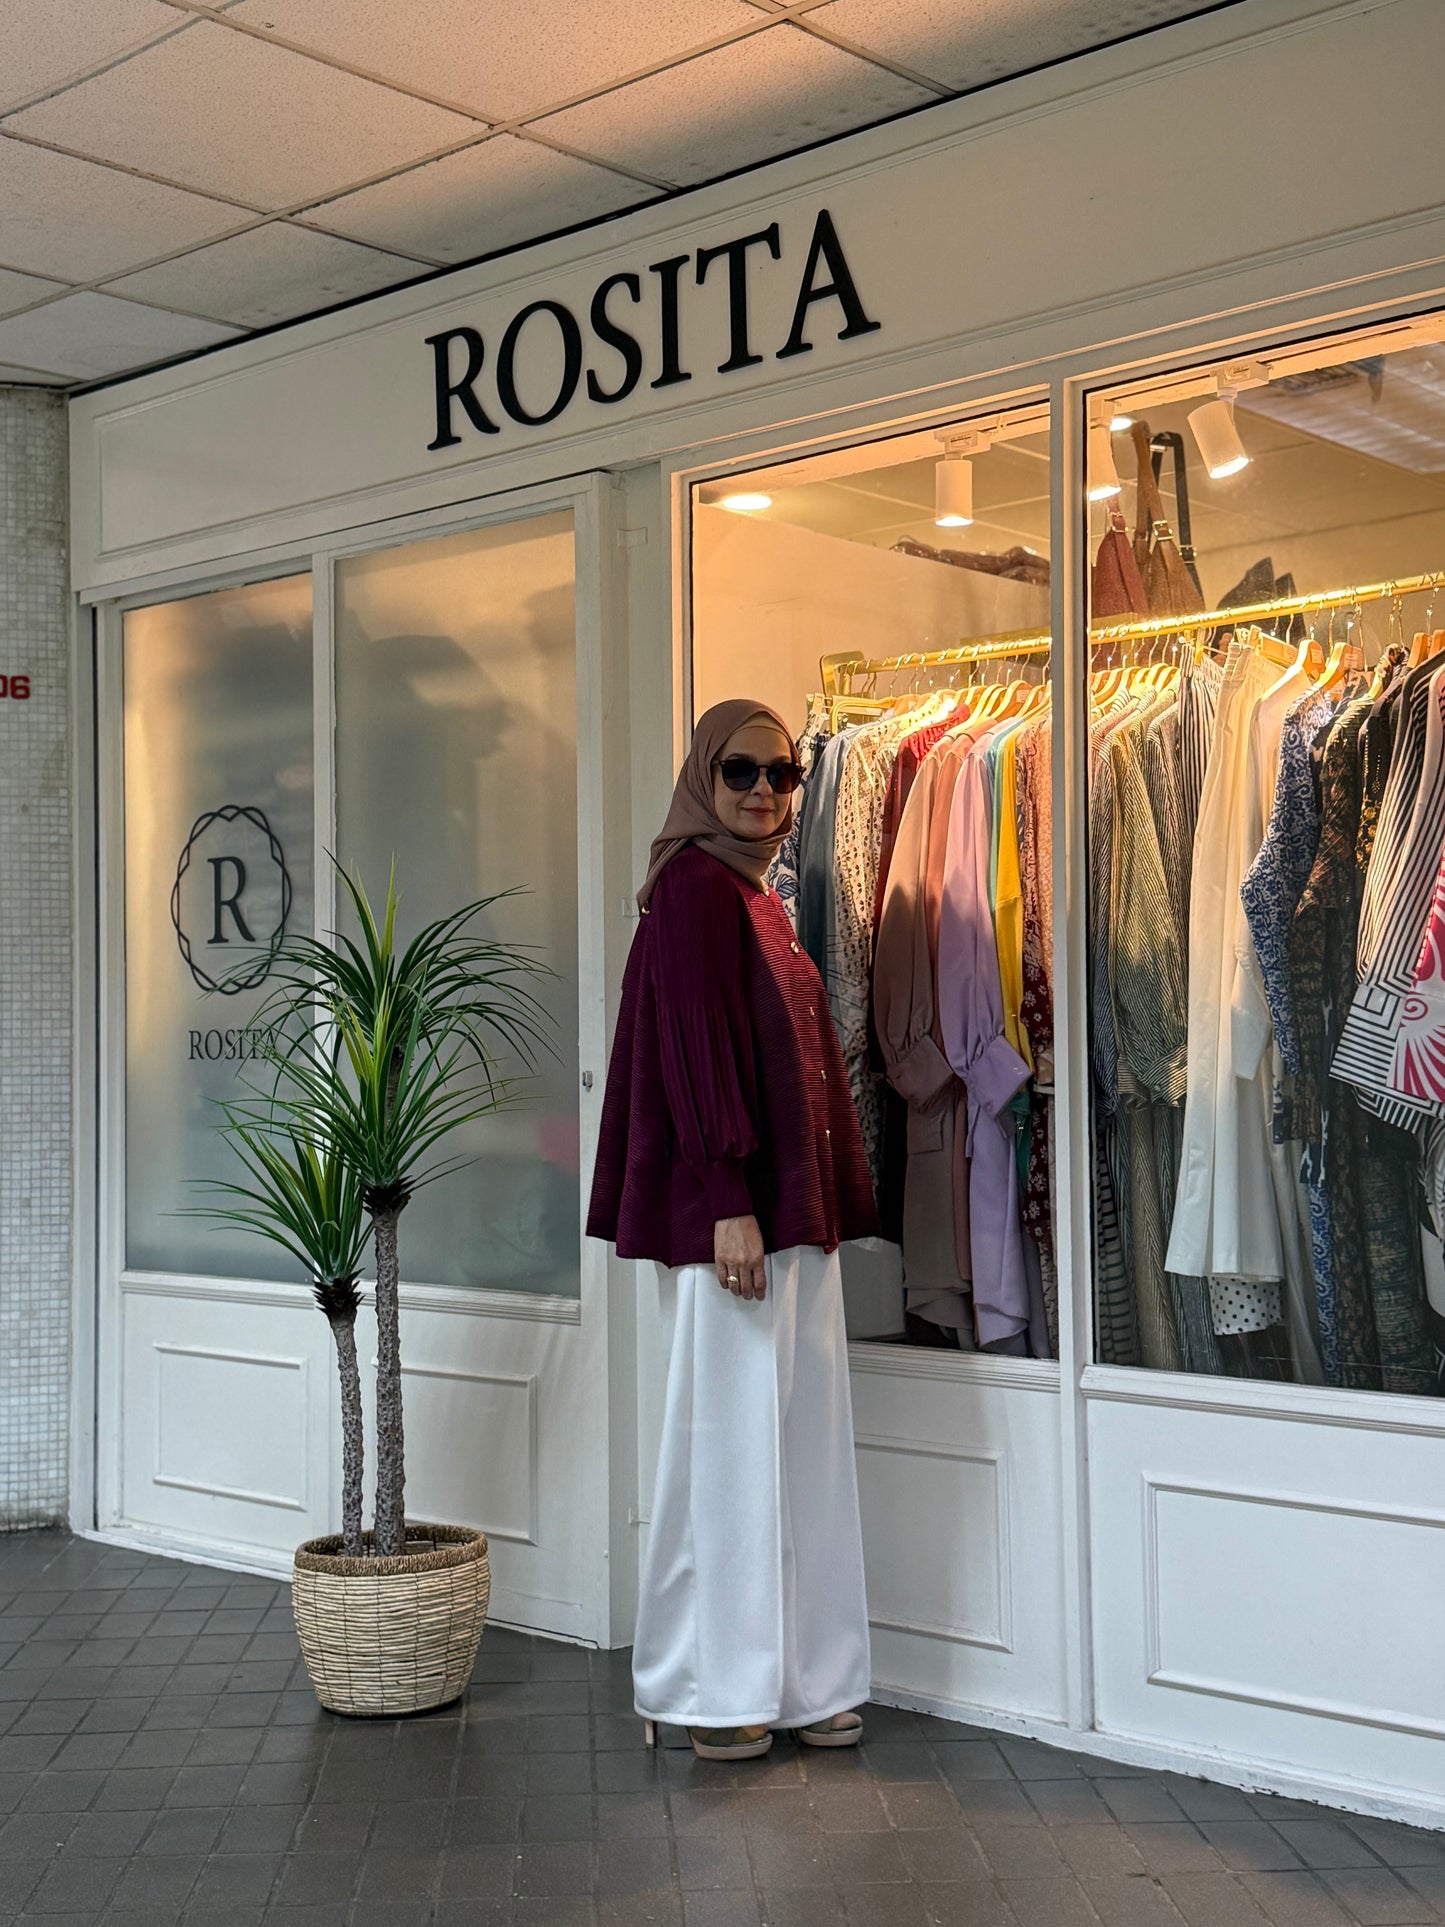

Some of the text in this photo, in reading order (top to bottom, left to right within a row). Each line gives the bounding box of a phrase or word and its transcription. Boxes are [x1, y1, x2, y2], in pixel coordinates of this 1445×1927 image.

[424, 208, 881, 451] ROSITA
[207, 856, 256, 944] R
[188, 1028, 278, 1060] ROSITA
